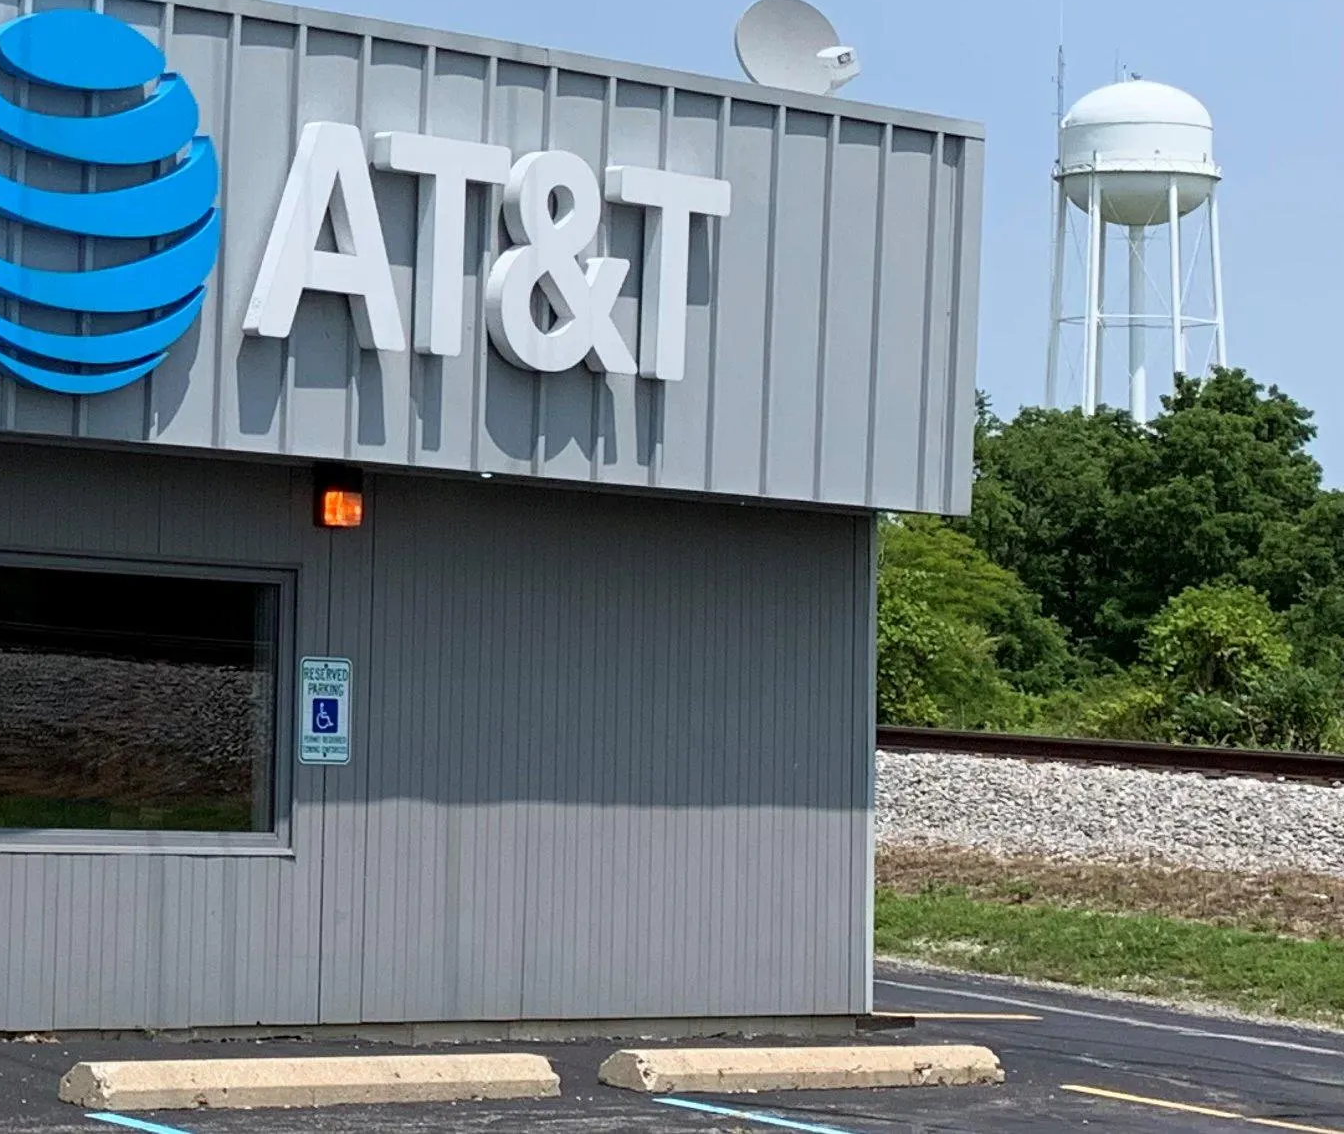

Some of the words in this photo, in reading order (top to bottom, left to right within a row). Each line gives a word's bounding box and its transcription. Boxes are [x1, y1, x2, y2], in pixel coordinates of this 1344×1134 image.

[242, 121, 731, 381] AT&T
[303, 667, 348, 682] RESERVED
[308, 682, 344, 697] PARKING
